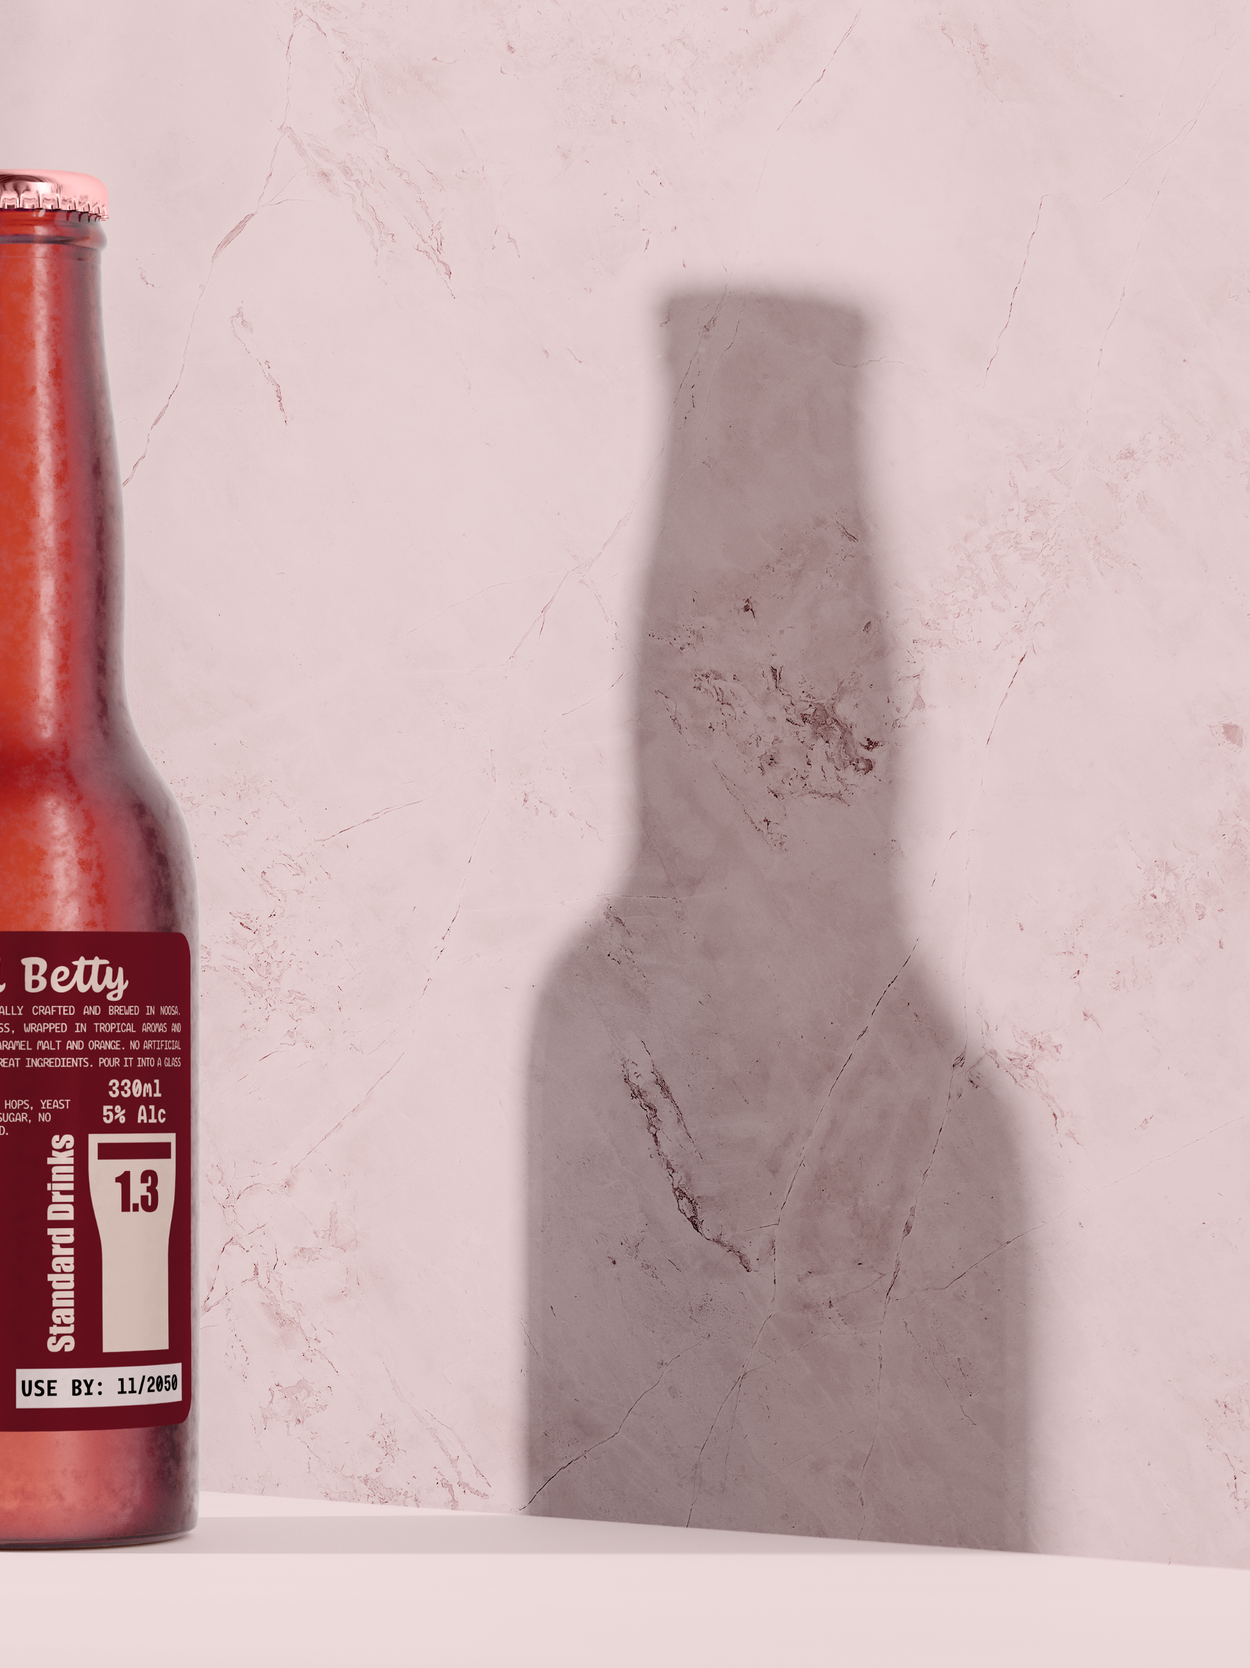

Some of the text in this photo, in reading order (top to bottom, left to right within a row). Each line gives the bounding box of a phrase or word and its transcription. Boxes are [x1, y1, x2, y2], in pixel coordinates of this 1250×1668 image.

[21, 956, 128, 1001] Betty
[31, 1005, 76, 1016] CRAFTED
[82, 1005, 102, 1016] AND
[108, 1005, 140, 1016] BREWED
[145, 1005, 156, 1016] IN
[159, 1005, 181, 1016] NOOSA.
[23, 1022, 68, 1033] WRAPPED
[74, 1022, 87, 1033] IN
[93, 1022, 137, 1033] TROPICAL
[141, 1022, 168, 1033] AROMAS
[170, 1022, 182, 1033] AND
[36, 1039, 62, 1051] MALT
[65, 1039, 85, 1051] AND
[87, 1039, 125, 1051] ORANGE.
[129, 1039, 141, 1051] NO
[142, 1039, 182, 1051] ARTIFICIAL
[25, 1057, 93, 1068] INGREDIENTS.
[98, 1056, 121, 1068] POUR
[123, 1057, 134, 1068] IT
[136, 1056, 155, 1068] INTO
[156, 1056, 162, 1067] A
[163, 1056, 182, 1068] GLASS
[109, 1079, 161, 1097] 330ml
[4, 1099, 34, 1111] HOPS,
[39, 1098, 71, 1110] YEAST
[38, 1111, 52, 1123] NO
[103, 1105, 166, 1123] 5% Alc
[115, 1170, 158, 1212] 1.3
[47, 1134, 75, 1353] Standard Drinks
[22, 1374, 177, 1397] USE BY: 11/2050
